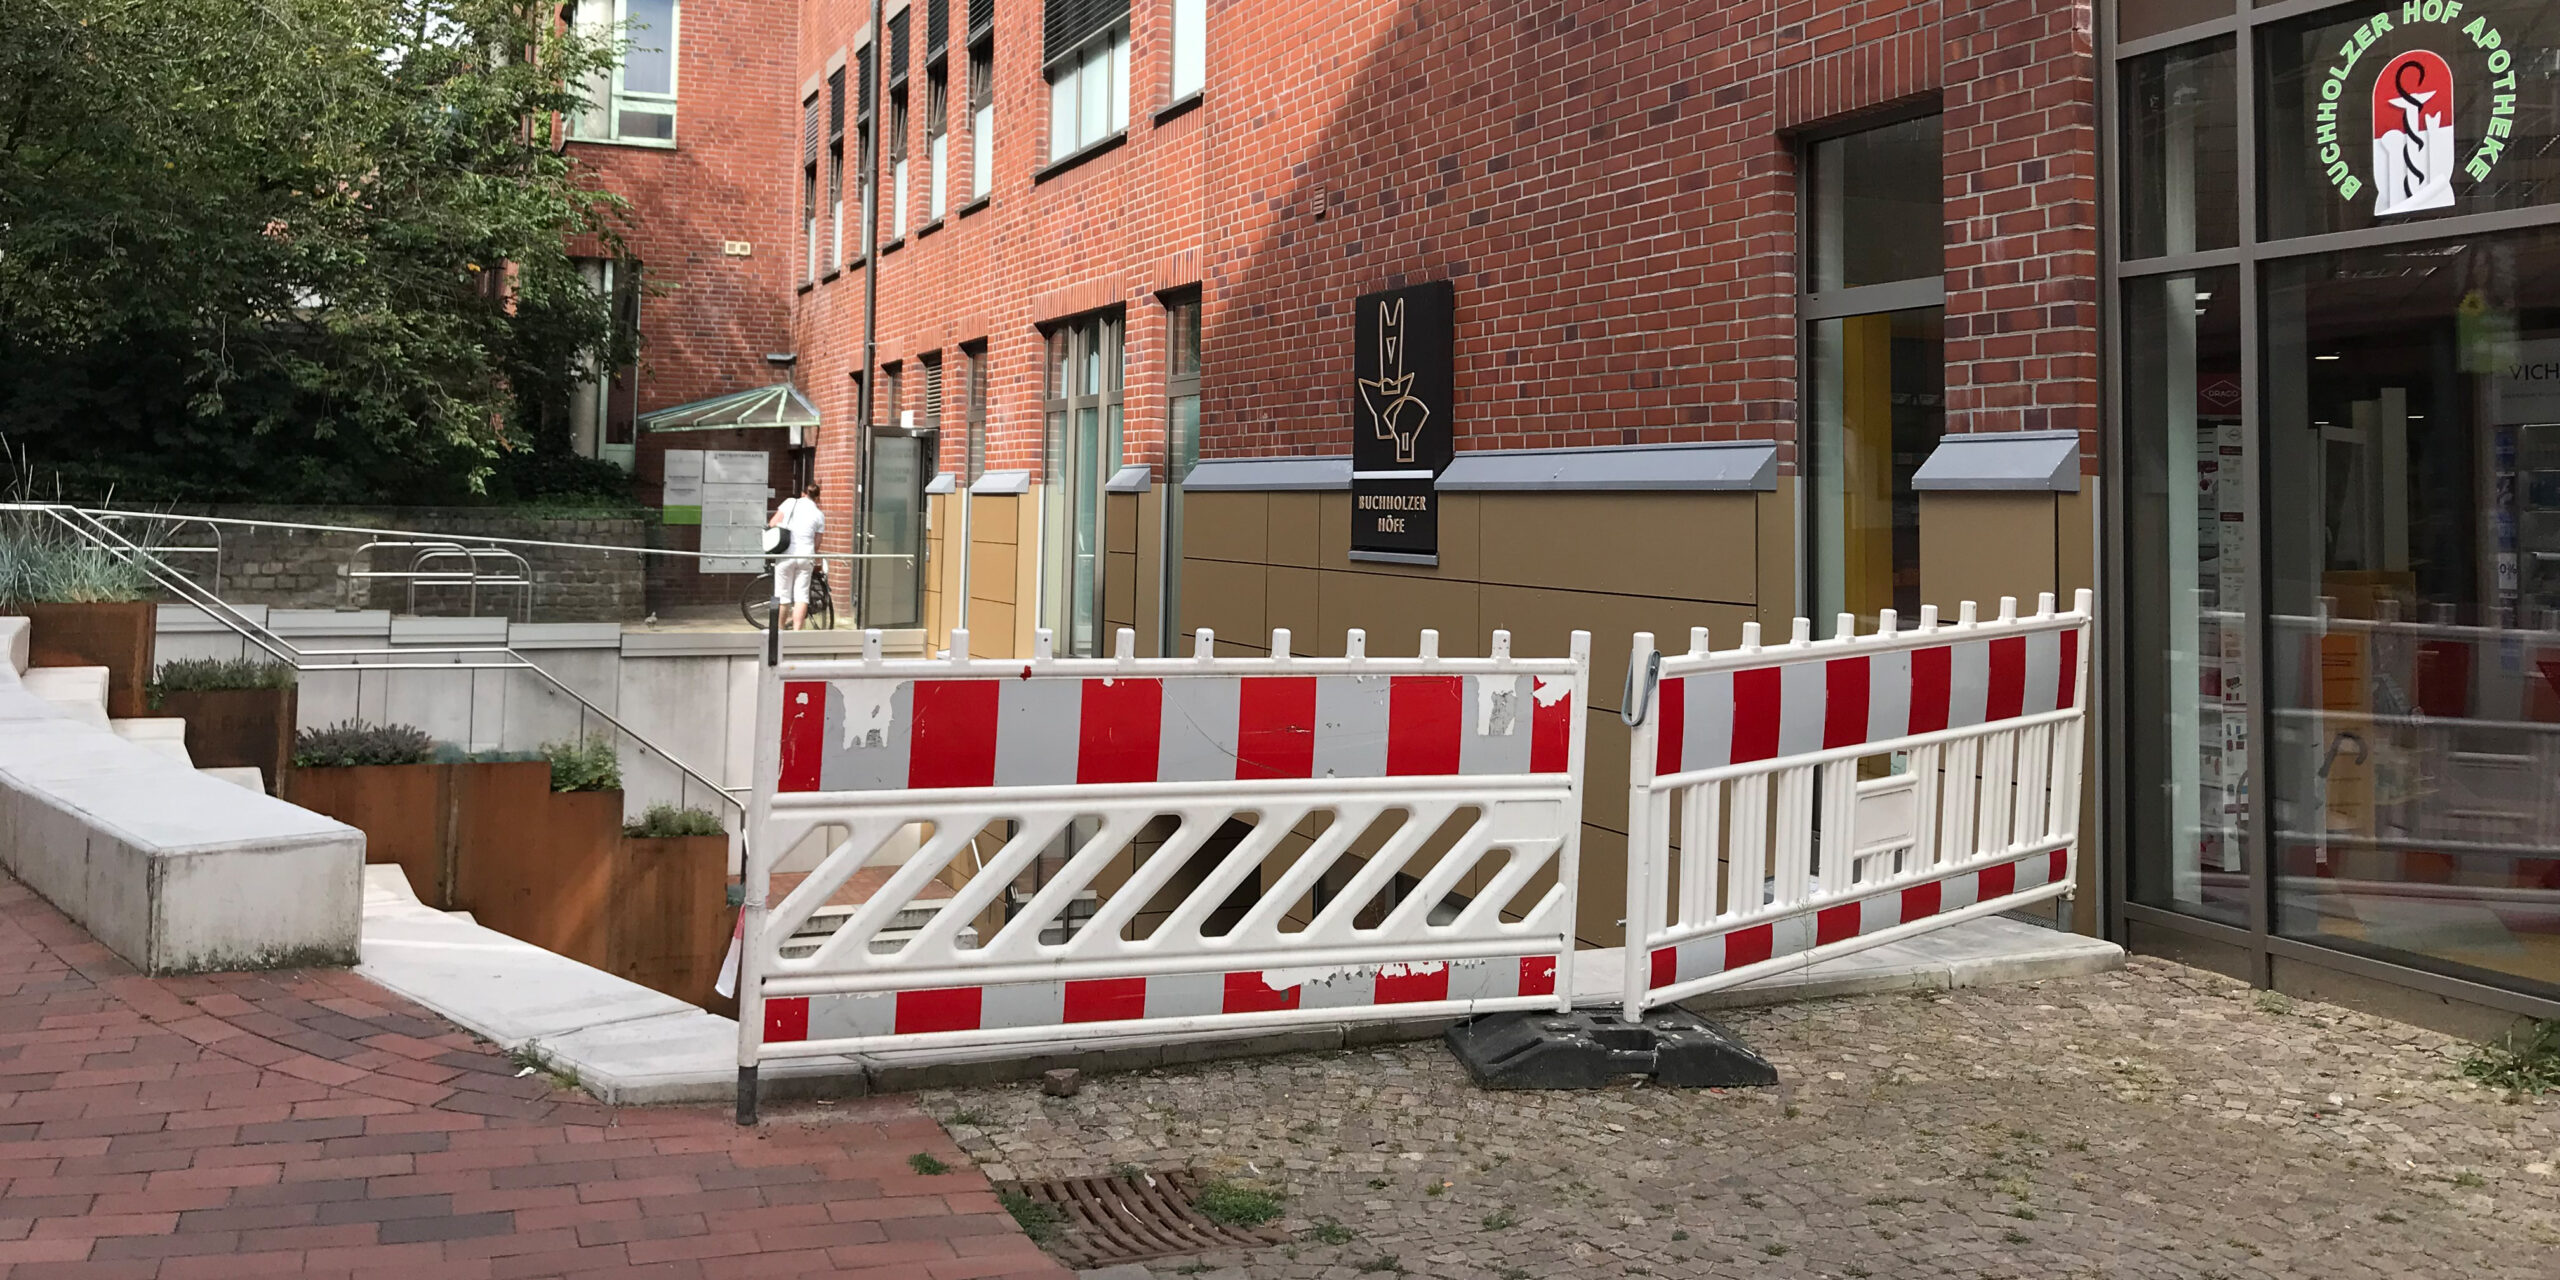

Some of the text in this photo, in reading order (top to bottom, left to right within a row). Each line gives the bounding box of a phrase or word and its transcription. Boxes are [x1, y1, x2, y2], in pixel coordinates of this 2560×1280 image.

[2317, 0, 2516, 201] BUCHHOLZER HOF APOTHEKE
[1358, 495, 1427, 511] BUCHHOLZER
[1377, 514, 1405, 533] HÖFE
